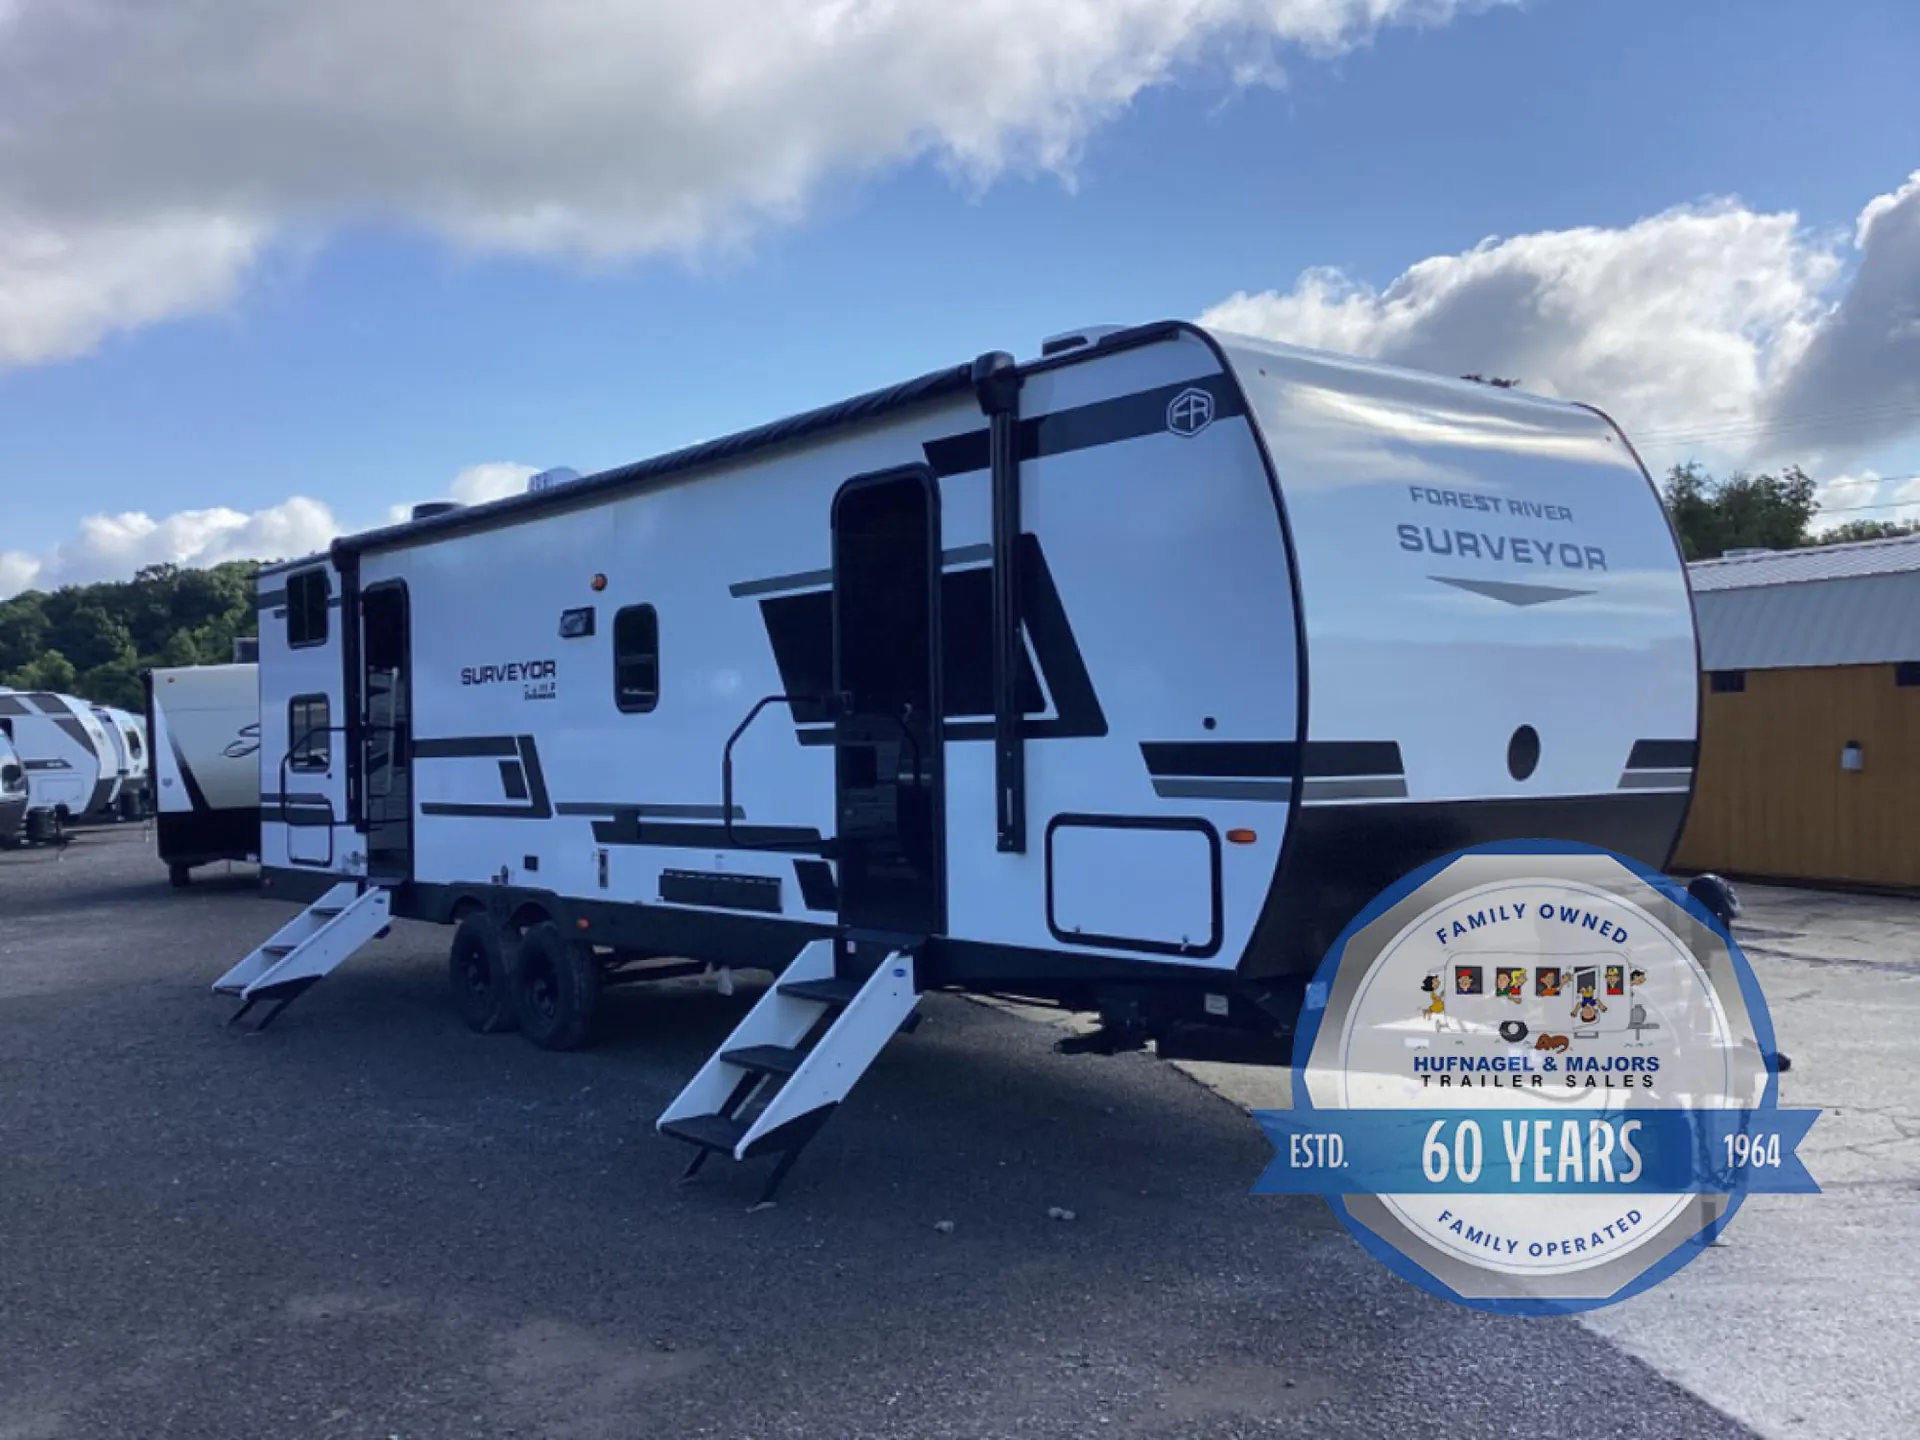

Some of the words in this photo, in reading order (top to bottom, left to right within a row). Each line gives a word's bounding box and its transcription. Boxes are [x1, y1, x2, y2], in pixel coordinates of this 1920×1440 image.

[1408, 485, 1500, 513] FOREST
[1506, 499, 1573, 522] RIVER
[1397, 524, 1608, 571] SURVEYOR
[461, 660, 556, 685] SURVEYOR
